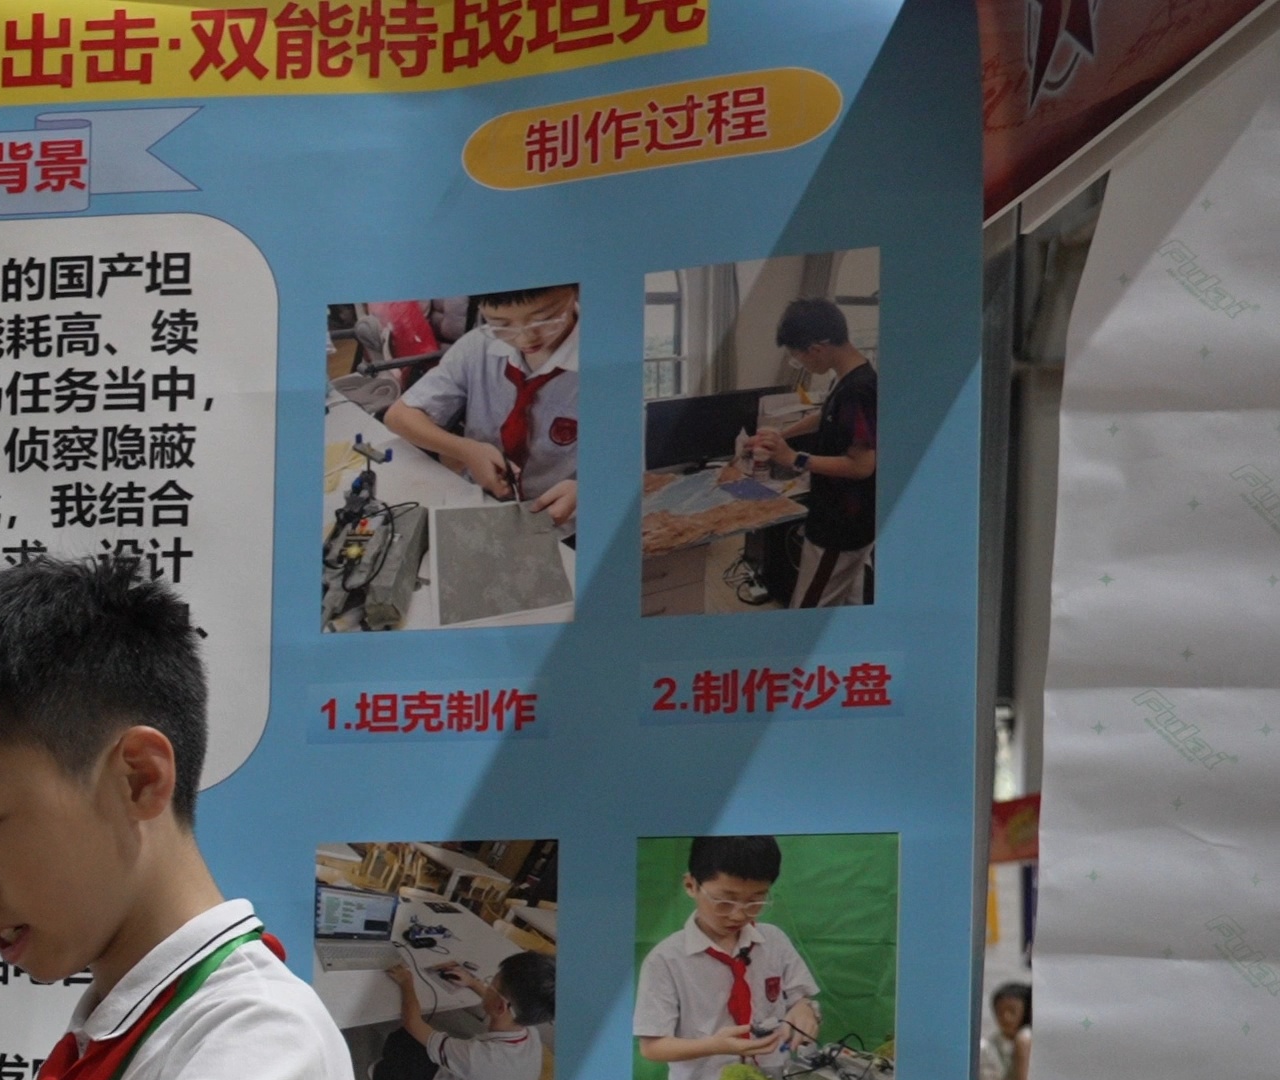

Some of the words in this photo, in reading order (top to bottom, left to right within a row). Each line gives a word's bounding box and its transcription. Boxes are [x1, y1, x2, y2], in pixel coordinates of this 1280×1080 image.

[524, 86, 767, 173] 制作过程
[321, 689, 538, 733] 1.坦克制作
[652, 662, 892, 717] 2.制作沙盘
